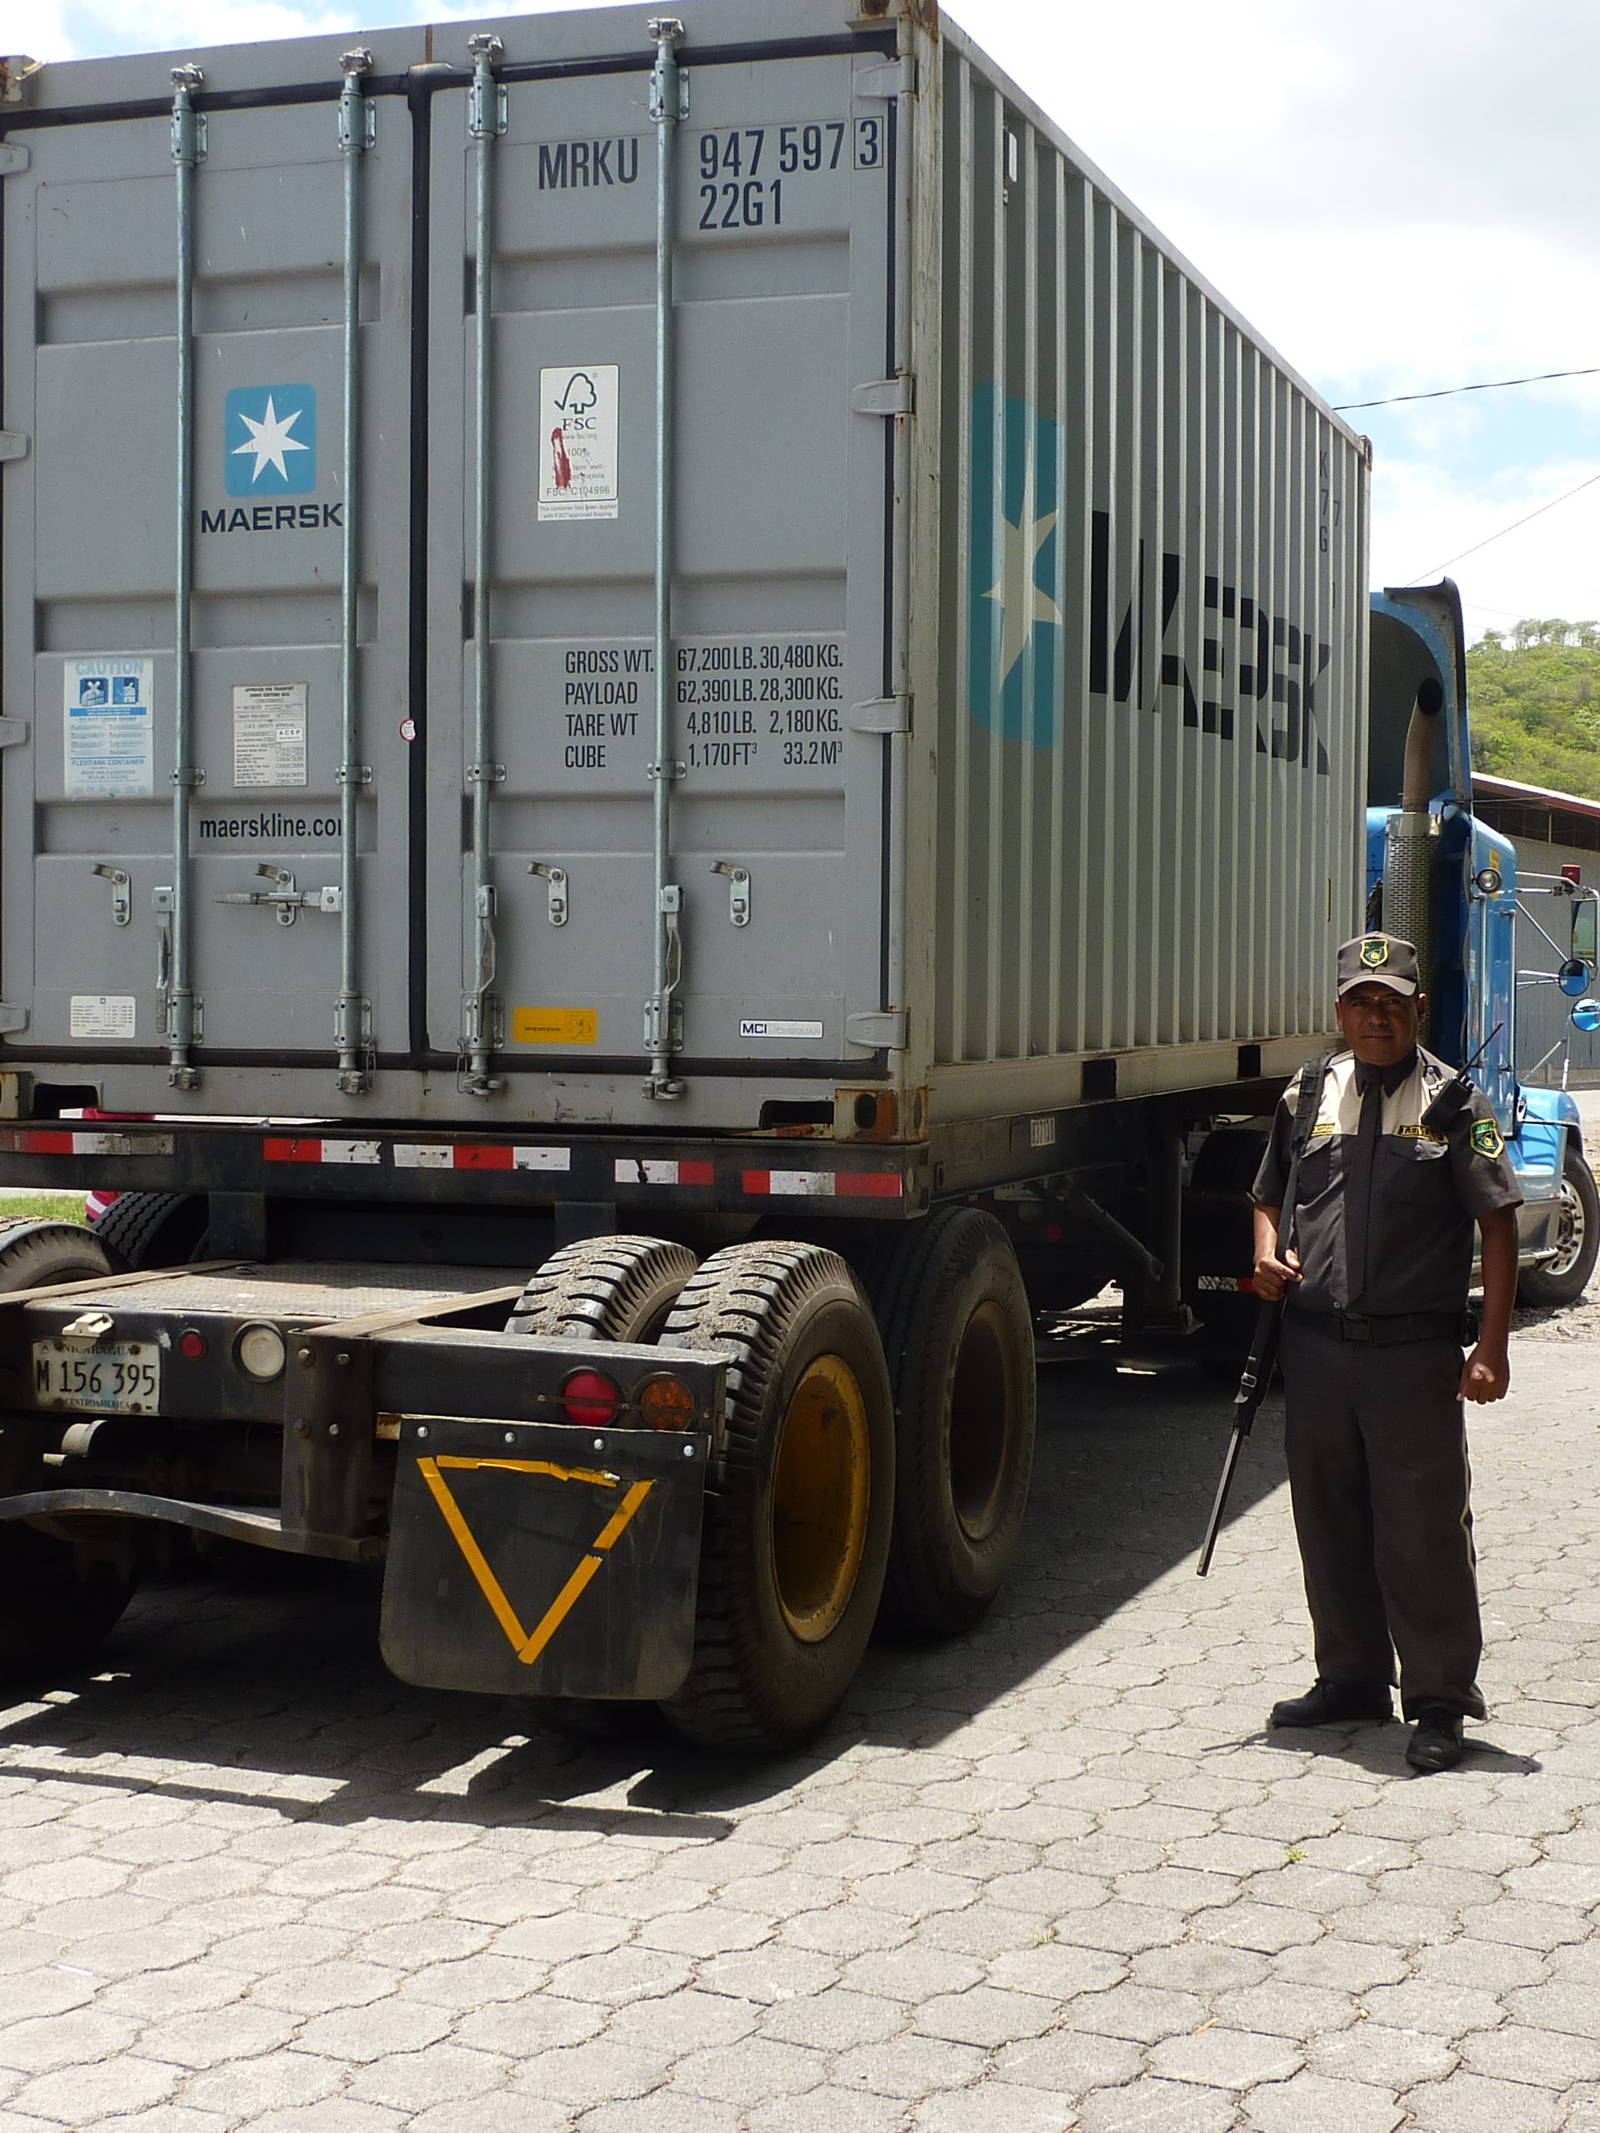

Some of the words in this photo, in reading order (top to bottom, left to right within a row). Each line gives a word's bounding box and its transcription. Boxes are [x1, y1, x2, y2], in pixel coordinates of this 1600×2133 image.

[700, 130, 764, 180] 947
[779, 122, 845, 174] 597
[858, 119, 879, 166] 3
[538, 138, 638, 190] MRKU
[699, 180, 782, 230] 22G1
[561, 417, 597, 431] FSC
[201, 503, 344, 533] MAERSK
[565, 650, 619, 673] GROSS
[624, 649, 654, 672] WT.
[565, 681, 637, 705] PAYLOAD
[565, 713, 606, 736] TARE
[610, 713, 639, 736] WT
[565, 745, 606, 768] CUBE
[783, 742, 818, 765] 33.2
[742, 1023, 767, 1034] MCI
[36, 1360, 50, 1392] M
[60, 1361, 102, 1394] 156
[112, 1363, 155, 1396] 395
